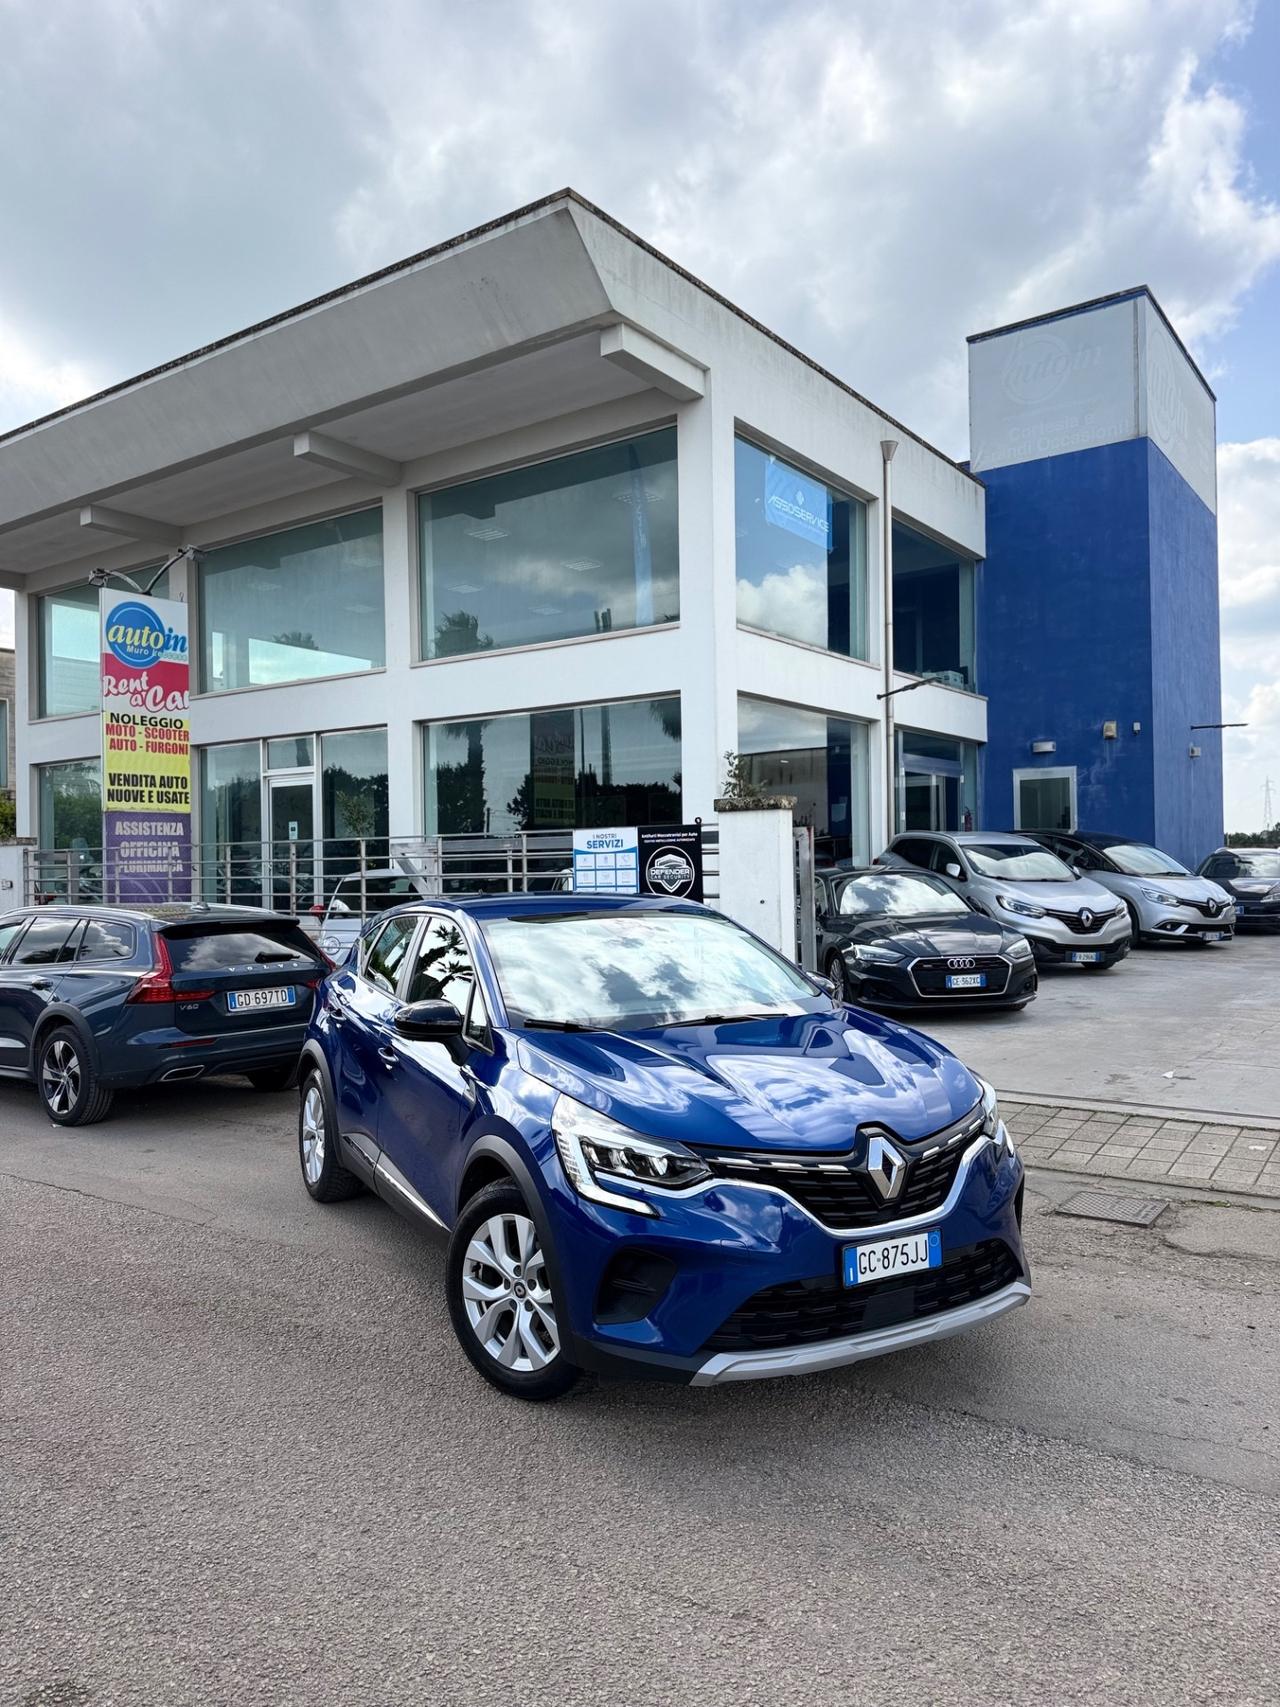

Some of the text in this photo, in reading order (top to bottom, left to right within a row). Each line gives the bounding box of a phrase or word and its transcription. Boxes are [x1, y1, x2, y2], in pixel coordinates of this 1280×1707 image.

[127, 645, 149, 655] Muro
[103, 671, 149, 697] Rent
[110, 713, 183, 729] NOLEGGIO
[106, 723, 135, 738] MOTO
[144, 726, 189, 742] SCOOTER
[109, 738, 137, 751] AUTO
[145, 742, 188, 755] FURGONI
[109, 772, 188, 789] VENDITA AUTO
[107, 788, 190, 804] NUOVE E USATE
[115, 821, 184, 836] ASSISTENZA
[120, 841, 180, 857] OFFICINA
[586, 839, 624, 849] SERVIZI
[228, 962, 298, 972] VOLVO
